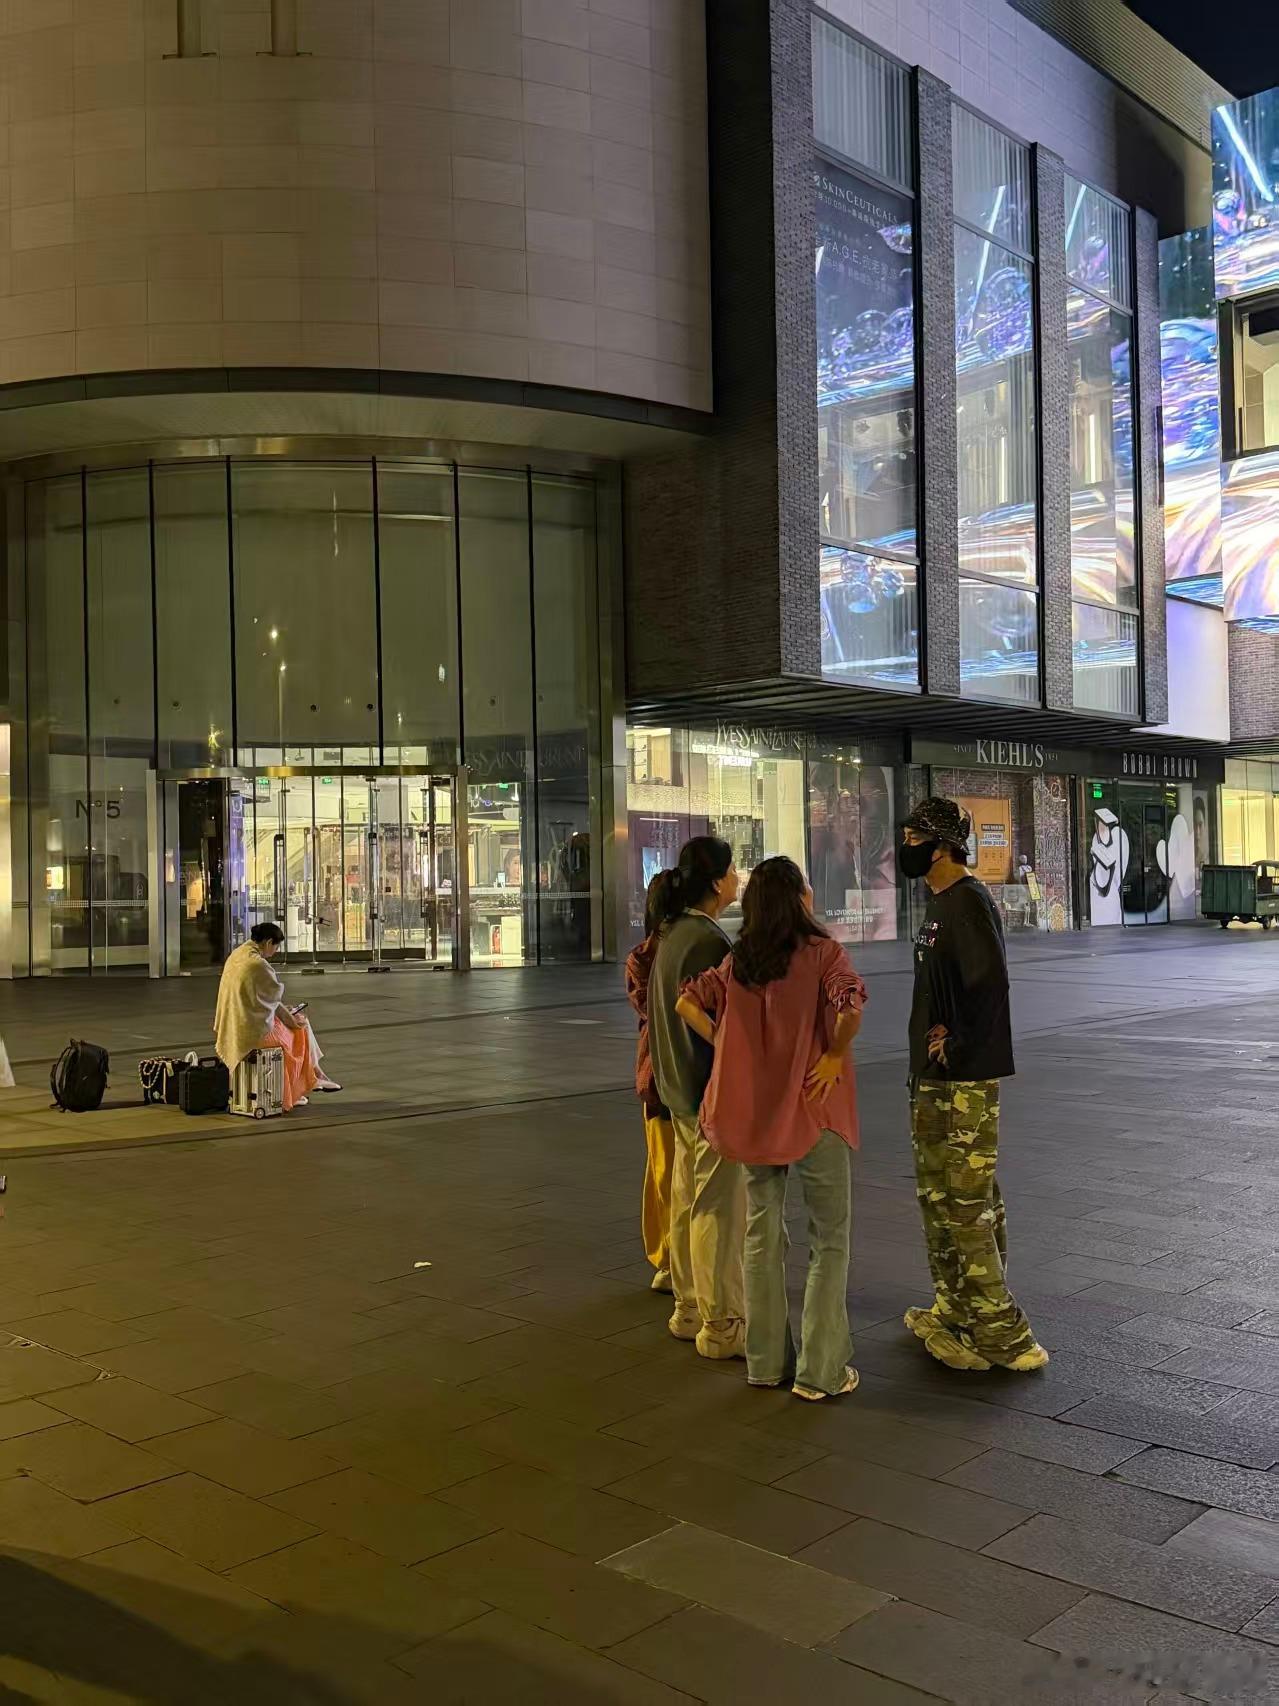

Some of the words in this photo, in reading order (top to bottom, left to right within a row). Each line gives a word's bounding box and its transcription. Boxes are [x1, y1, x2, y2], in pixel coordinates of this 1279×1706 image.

[771, 727, 818, 751] LAUREN
[976, 739, 1044, 768] KIEHL'S
[1123, 752, 1156, 776] BOBBI
[1163, 756, 1198, 778] BROWN
